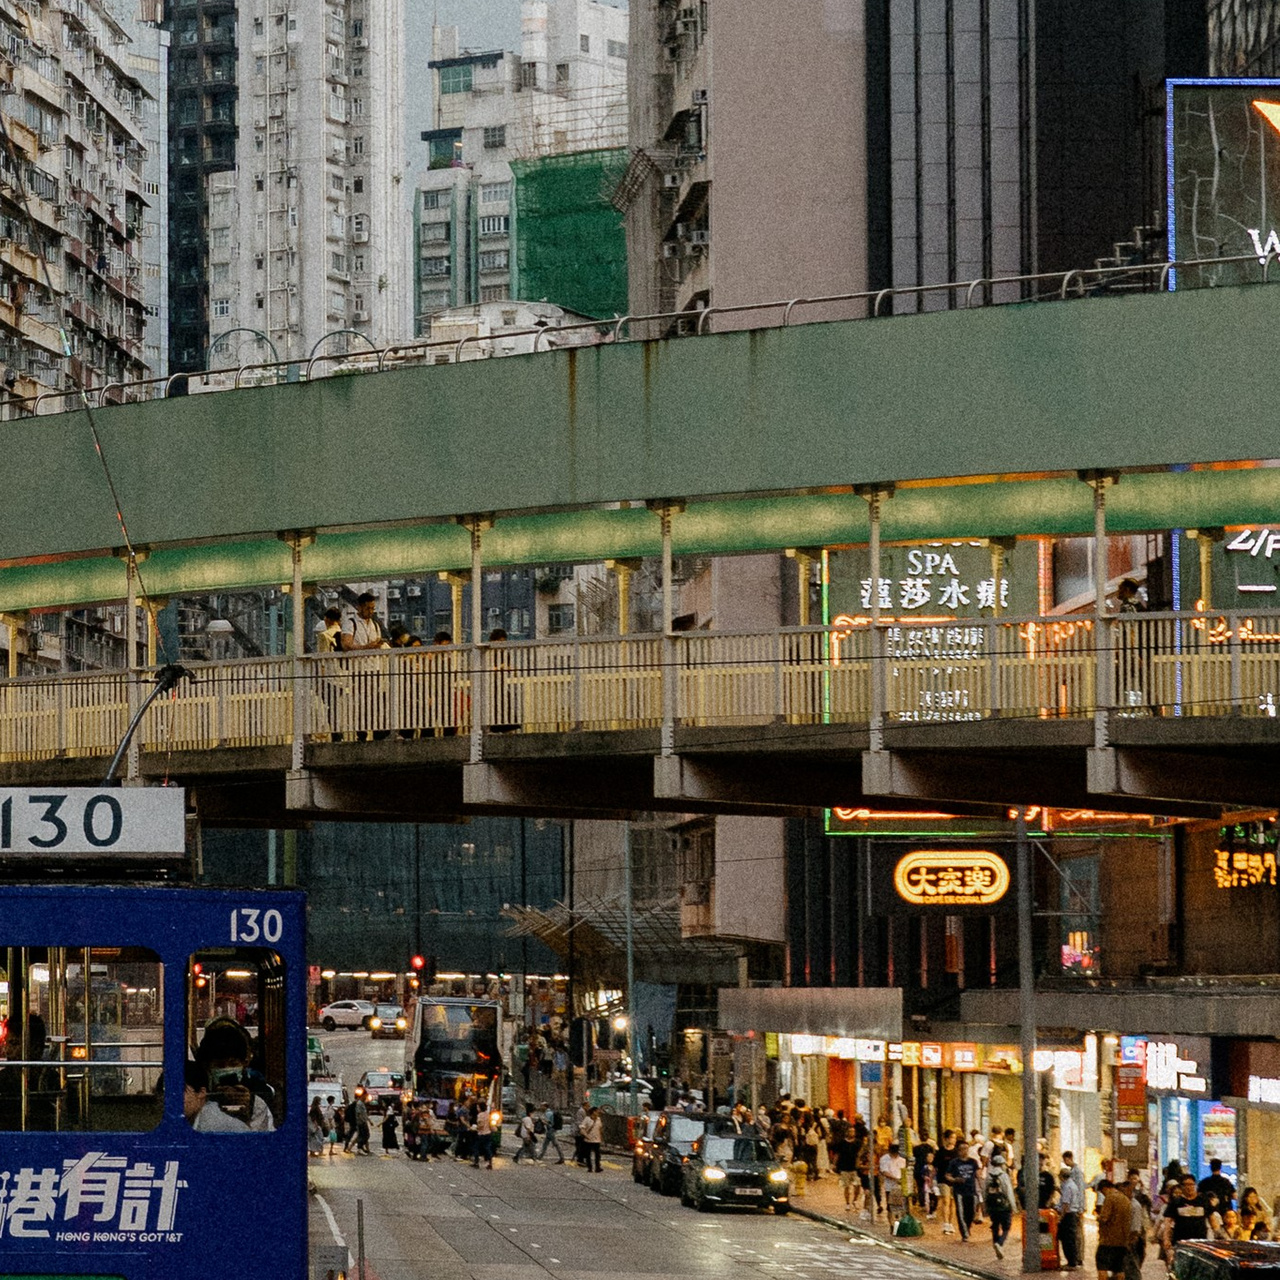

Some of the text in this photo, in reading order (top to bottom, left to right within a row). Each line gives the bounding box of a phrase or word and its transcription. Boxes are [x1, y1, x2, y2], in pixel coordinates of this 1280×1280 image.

[908, 550, 960, 576] SPA
[1, 794, 123, 849] 130
[230, 908, 283, 943] 130
[56, 1232, 90, 1242] HONG
[93, 1231, 136, 1242] KONG'S
[139, 1232, 163, 1243] GOT
